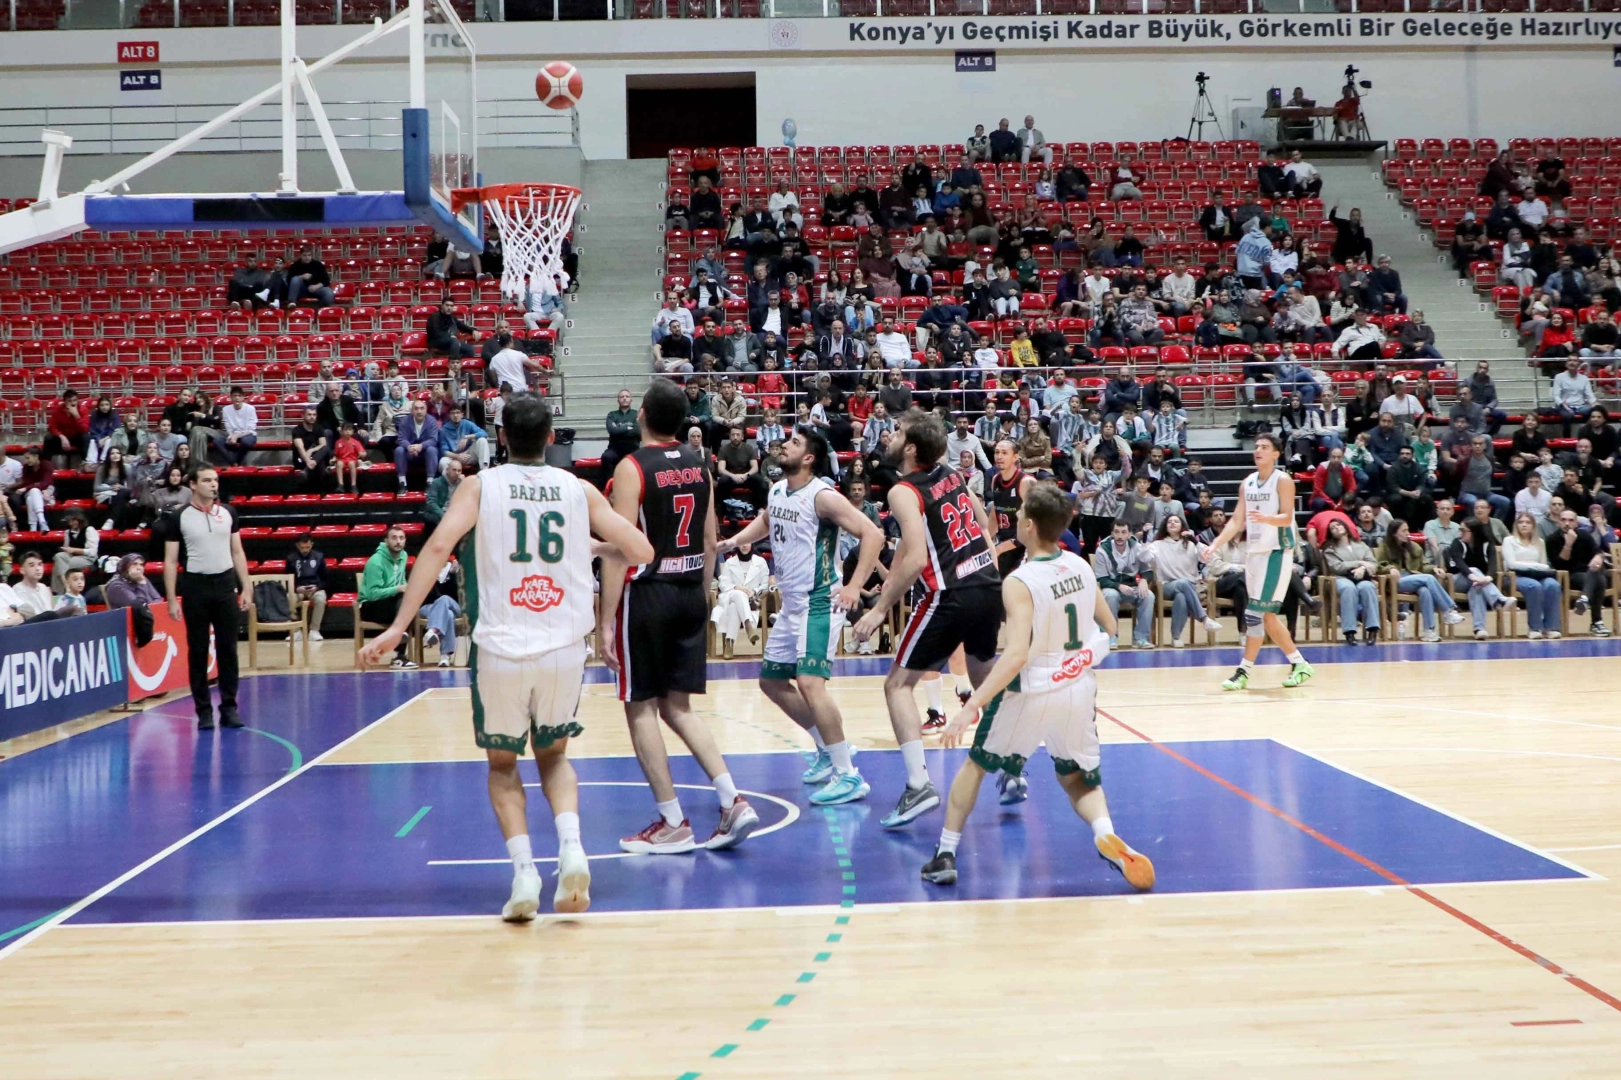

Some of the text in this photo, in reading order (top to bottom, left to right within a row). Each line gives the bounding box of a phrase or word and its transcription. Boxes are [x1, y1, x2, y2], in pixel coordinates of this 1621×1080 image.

[849, 22, 954, 44] Konya'yı
[962, 20, 1059, 42] Geçmişi
[1067, 20, 1140, 39] Kadar
[1148, 19, 1231, 42] Büyük,
[1239, 18, 1352, 38] Görkemli
[1360, 18, 1395, 37] Bir
[1402, 17, 1513, 40] Geleceğe
[122, 45, 155, 58] ALT 8
[958, 57, 980, 67] ALT
[123, 75, 159, 85] ALT 8
[656, 292, 661, 300] E
[567, 320, 572, 328] D
[564, 347, 569, 356] C
[508, 484, 563, 502] BARAN
[673, 493, 695, 548] 7
[940, 492, 982, 552] 22
[508, 508, 566, 564] 16
[773, 523, 787, 544] 24
[524, 578, 549, 592] KAFE
[1050, 574, 1085, 600] KAZIM
[512, 589, 561, 603] KARATAY
[1063, 603, 1083, 651] 1
